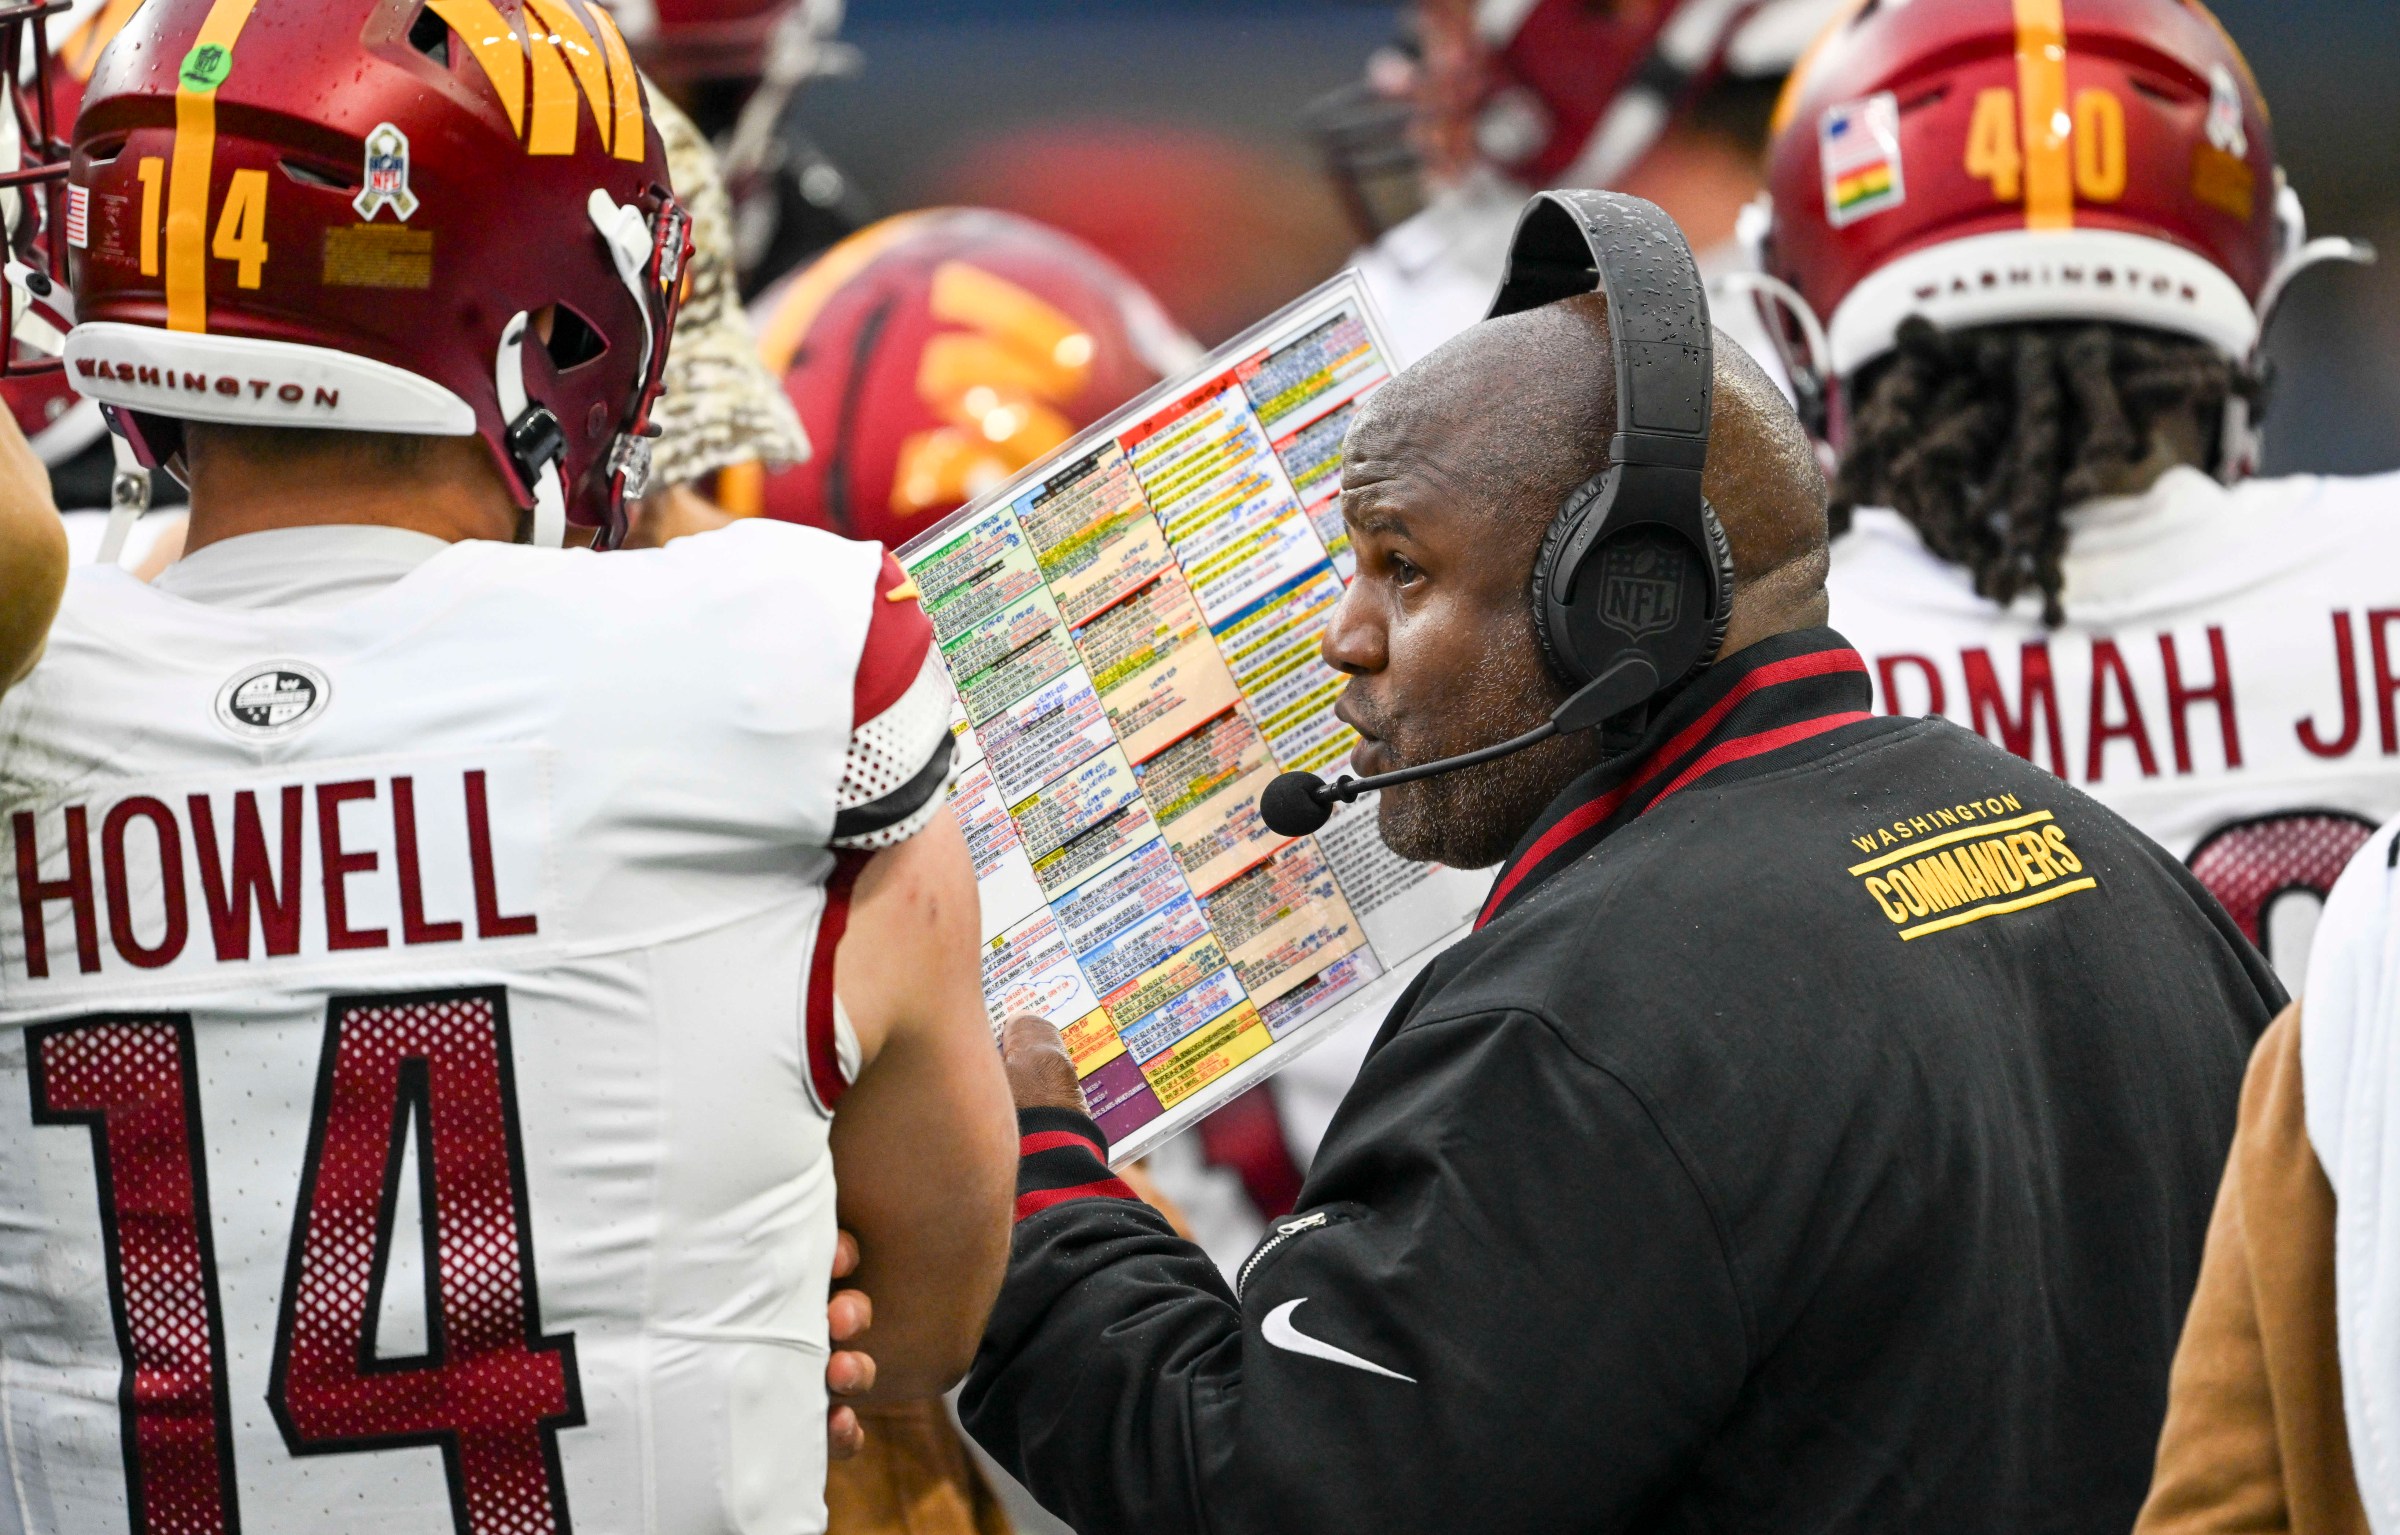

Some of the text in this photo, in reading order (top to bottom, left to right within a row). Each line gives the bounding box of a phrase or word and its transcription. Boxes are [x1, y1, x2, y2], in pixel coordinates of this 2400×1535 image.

[373, 171, 400, 190] NFL
[1964, 87, 2128, 202] 40
[137, 157, 269, 291] 14
[1914, 264, 2197, 302] WASHINGTON
[74, 355, 341, 409] WASHINGTON
[1607, 577, 1672, 627] NFL
[1851, 792, 2023, 854] WASHINGTON
[12, 769, 539, 979] HOWELL
[1864, 824, 2083, 925] COMMANDERS
[23, 983, 588, 1535] 14
